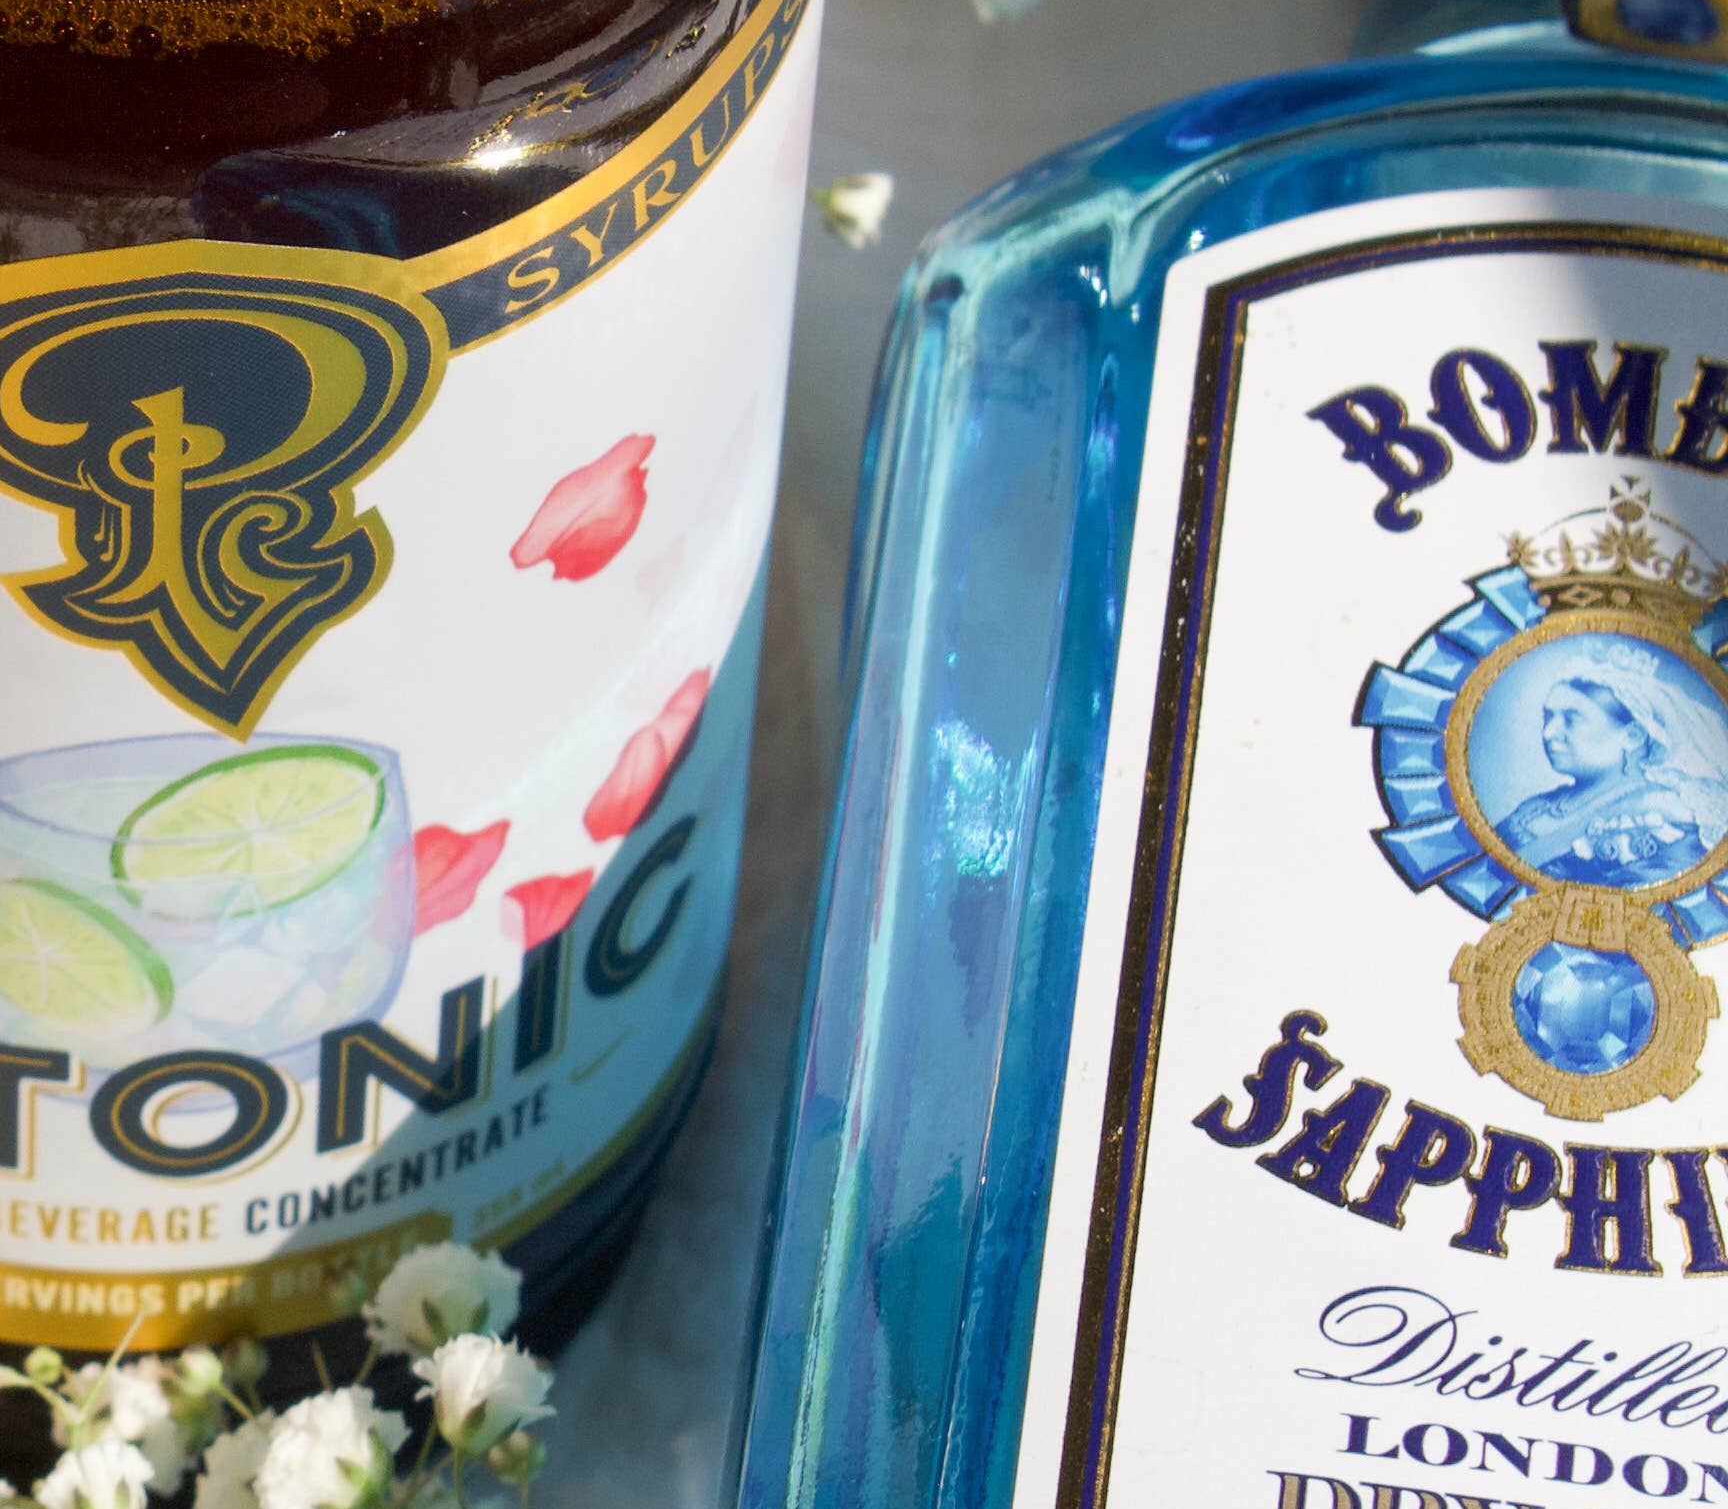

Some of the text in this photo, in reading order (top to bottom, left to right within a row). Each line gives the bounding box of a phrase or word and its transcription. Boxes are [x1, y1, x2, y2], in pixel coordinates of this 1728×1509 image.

[245, 1083, 550, 1236] CONCENTRATE
[1191, 1008, 1728, 1279] SAPPHI
[1293, 1285, 1728, 1435] Distille
